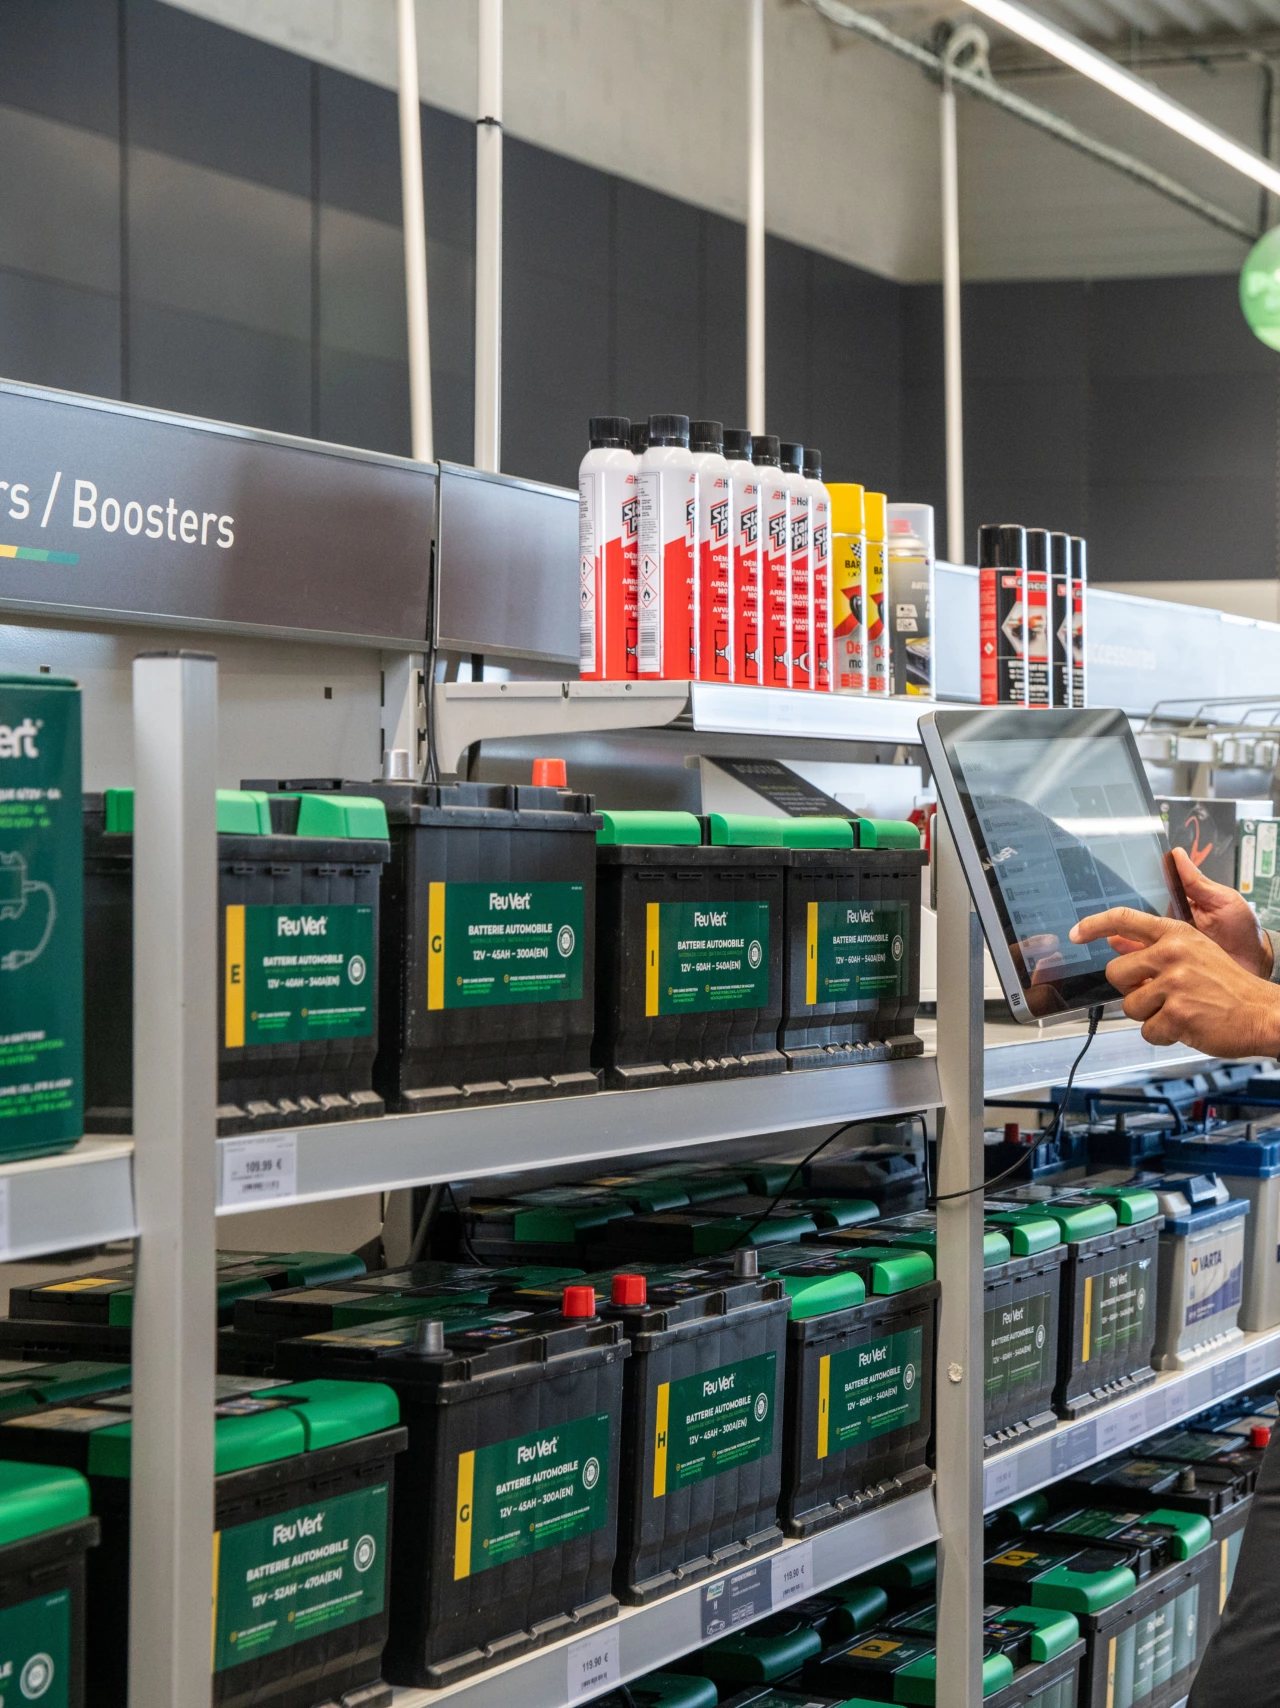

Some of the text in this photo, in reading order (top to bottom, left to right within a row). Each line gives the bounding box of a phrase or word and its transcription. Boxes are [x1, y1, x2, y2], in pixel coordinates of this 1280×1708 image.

[73, 479, 235, 549] Boosters
[845, 559, 860, 569] BAR
[489, 892, 531, 911] Feu Vert
[277, 915, 327, 937] Feu Vert
[694, 911, 727, 928] Feu Vert
[846, 909, 875, 924] Feu Vert
[468, 923, 553, 936] BATTERIE AUTOMOBILE
[832, 933, 889, 945] BATTERIE AUTOMOBILE
[431, 935, 442, 954] G
[473, 946, 549, 961] 12V 45AH 300A(EN)
[677, 938, 745, 951] BATTERIE AUTOMOBILE
[263, 953, 344, 967] BATTERIE AUTOMOBILE
[680, 959, 741, 973] 12V 60AH 540A(EN)
[835, 956, 845, 965] 12V
[847, 955, 861, 964] 60AH
[231, 964, 241, 984] E
[267, 979, 280, 989] 12V
[246, 1157, 282, 1173] 109.99 €
[1200, 1250, 1222, 1271] VARTA
[1002, 1307, 1024, 1326] Feu Vert
[859, 1345, 887, 1368] Feu Vert
[703, 1373, 735, 1397] Feu Vert
[844, 1365, 901, 1392] BATTERIE AUTOMOBILE
[685, 1395, 752, 1425] BATTERIE AUTOMOBILE
[847, 1401, 856, 1411] 12V
[859, 1395, 873, 1407] 60AH
[657, 1430, 666, 1449] H
[689, 1434, 700, 1446] 12V
[703, 1427, 718, 1440] 45AH
[517, 1437, 558, 1465] Feu Vert
[495, 1460, 579, 1496] BATTERIE AUTOMOBILE
[500, 1484, 574, 1519] 12V 45AH 300A(EN)
[459, 1504, 470, 1523] G
[272, 1513, 324, 1547] Feu Vert
[246, 1538, 349, 1583] BATTERIE AUTOMOBILE
[783, 1567, 800, 1582] 119.90
[252, 1592, 267, 1608] 12V
[274, 1582, 297, 1601] 52AH
[582, 1652, 609, 1672] 119.90 €
